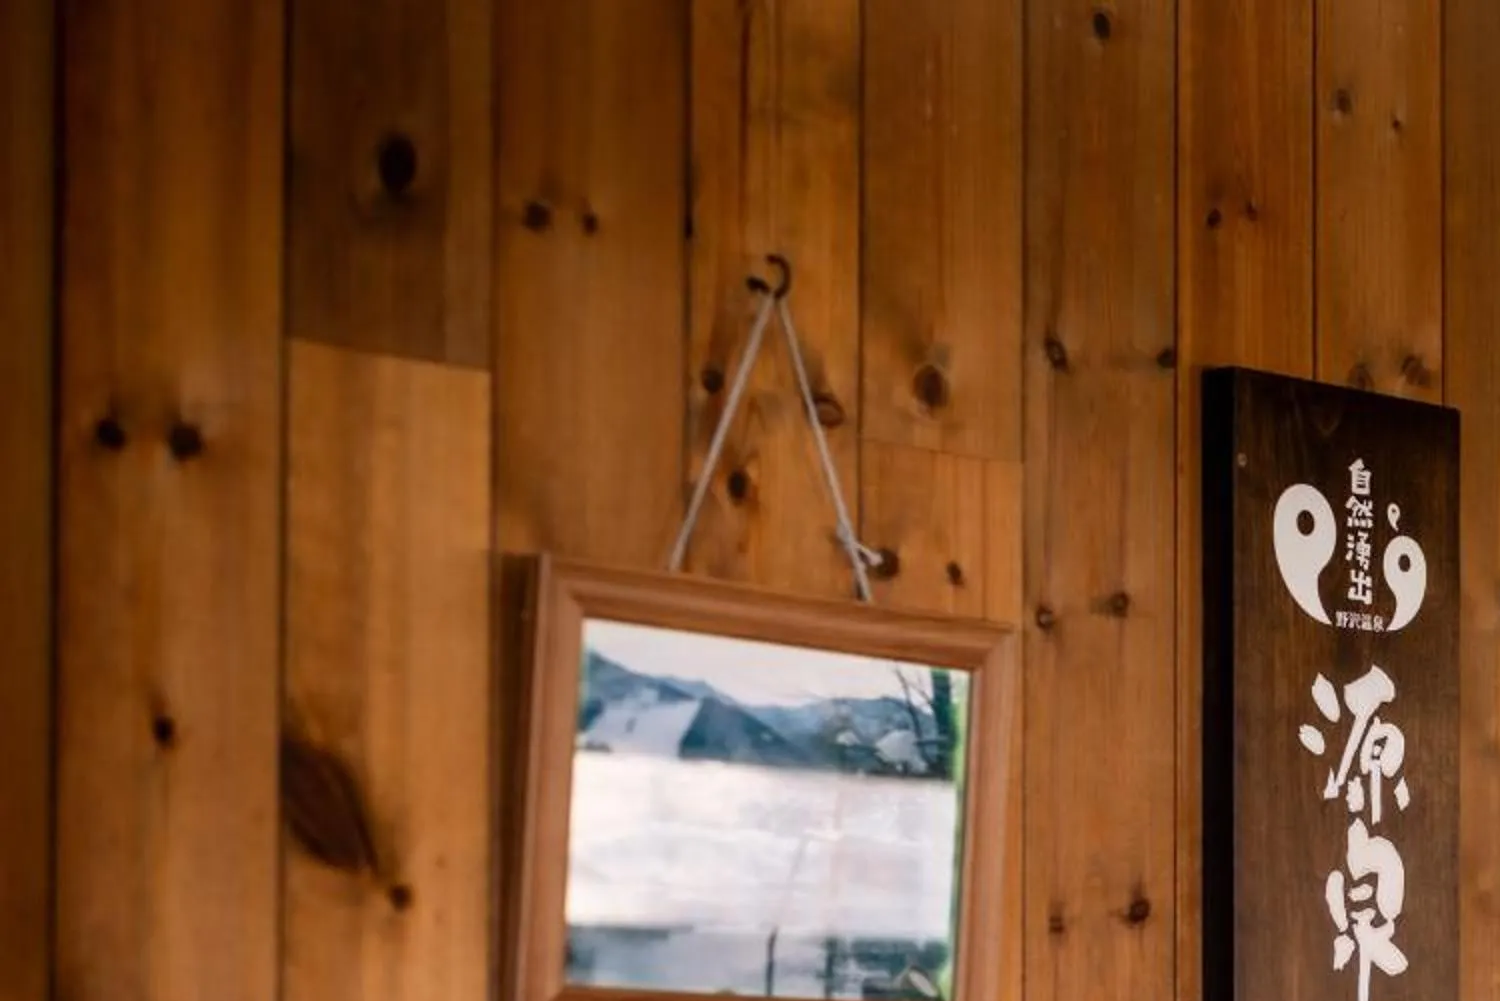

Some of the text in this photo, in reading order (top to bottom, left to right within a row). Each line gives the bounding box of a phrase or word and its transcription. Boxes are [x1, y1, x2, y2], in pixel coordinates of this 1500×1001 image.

[1345, 457, 1374, 605] 自然湧出
[1334, 610, 1385, 633] 野沢温泉
